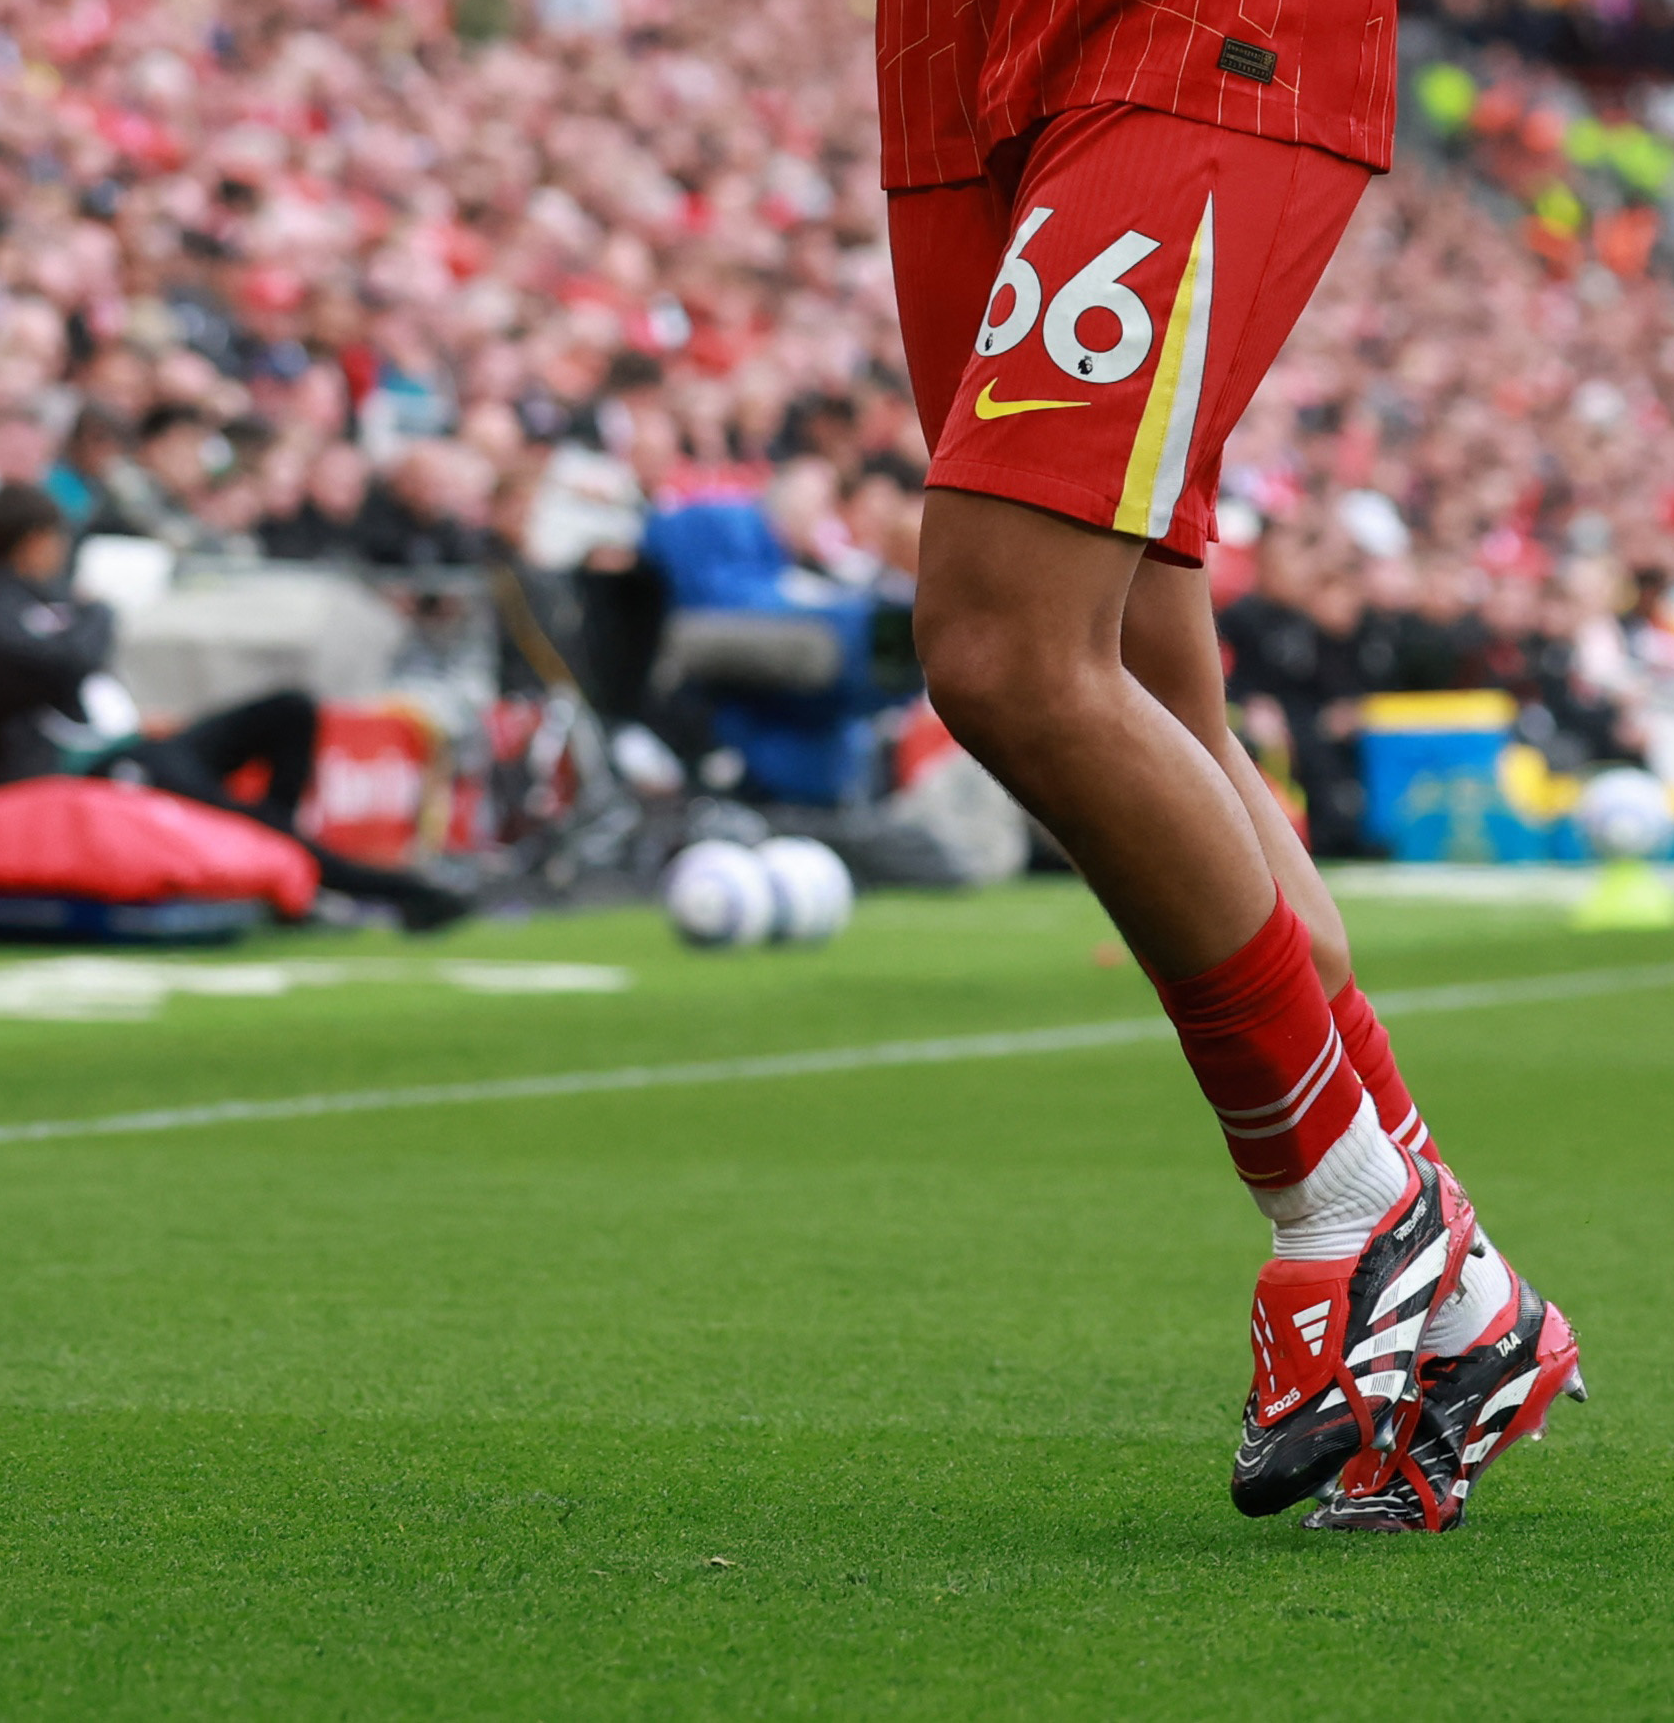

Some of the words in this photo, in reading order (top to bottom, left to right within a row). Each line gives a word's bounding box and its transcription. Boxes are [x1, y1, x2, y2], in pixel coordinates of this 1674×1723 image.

[975, 206, 1163, 384] 66
[1495, 1331, 1522, 1357] TAA
[1264, 1387, 1301, 1417] 2025
